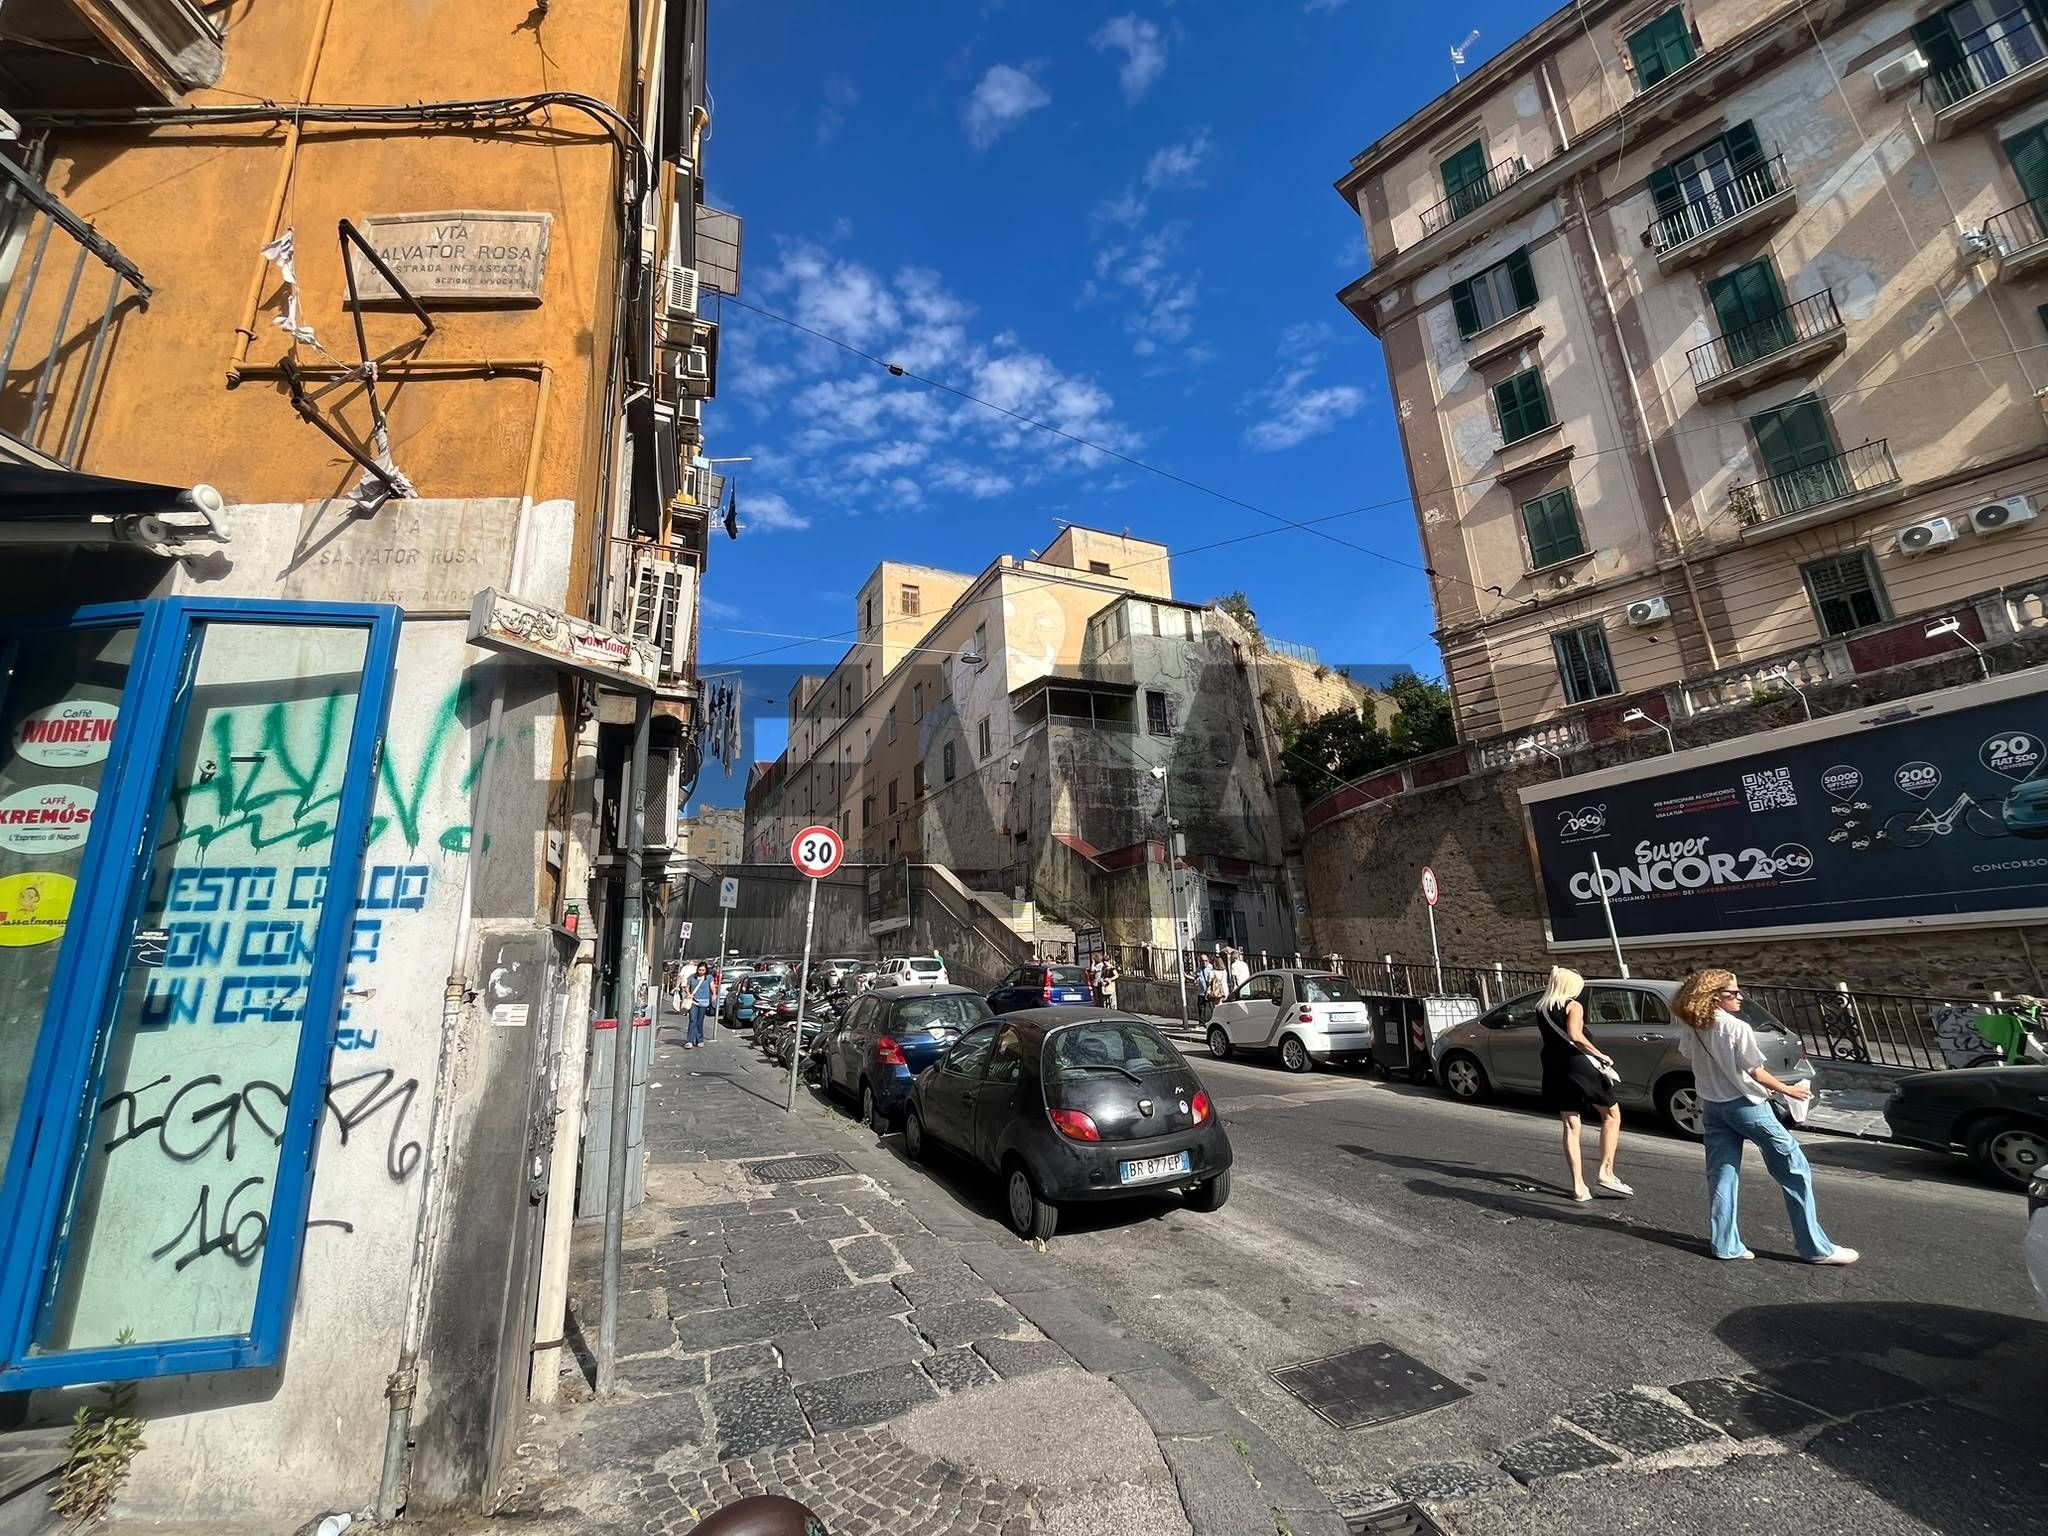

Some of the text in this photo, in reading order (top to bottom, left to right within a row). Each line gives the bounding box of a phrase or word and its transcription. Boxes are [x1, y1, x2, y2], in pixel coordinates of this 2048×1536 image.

[436, 226, 468, 240] VIA
[373, 245, 532, 261] ALVATOR ROSA
[20, 718, 117, 744] MOREN
[1989, 736, 2031, 760] 20
[2015, 753, 2039, 763] 500
[1898, 767, 1936, 784] 200
[0, 808, 94, 825] KREMOS
[803, 840, 833, 864] 30
[1635, 836, 1710, 864] Super
[1129, 1160, 1144, 1177] BR
